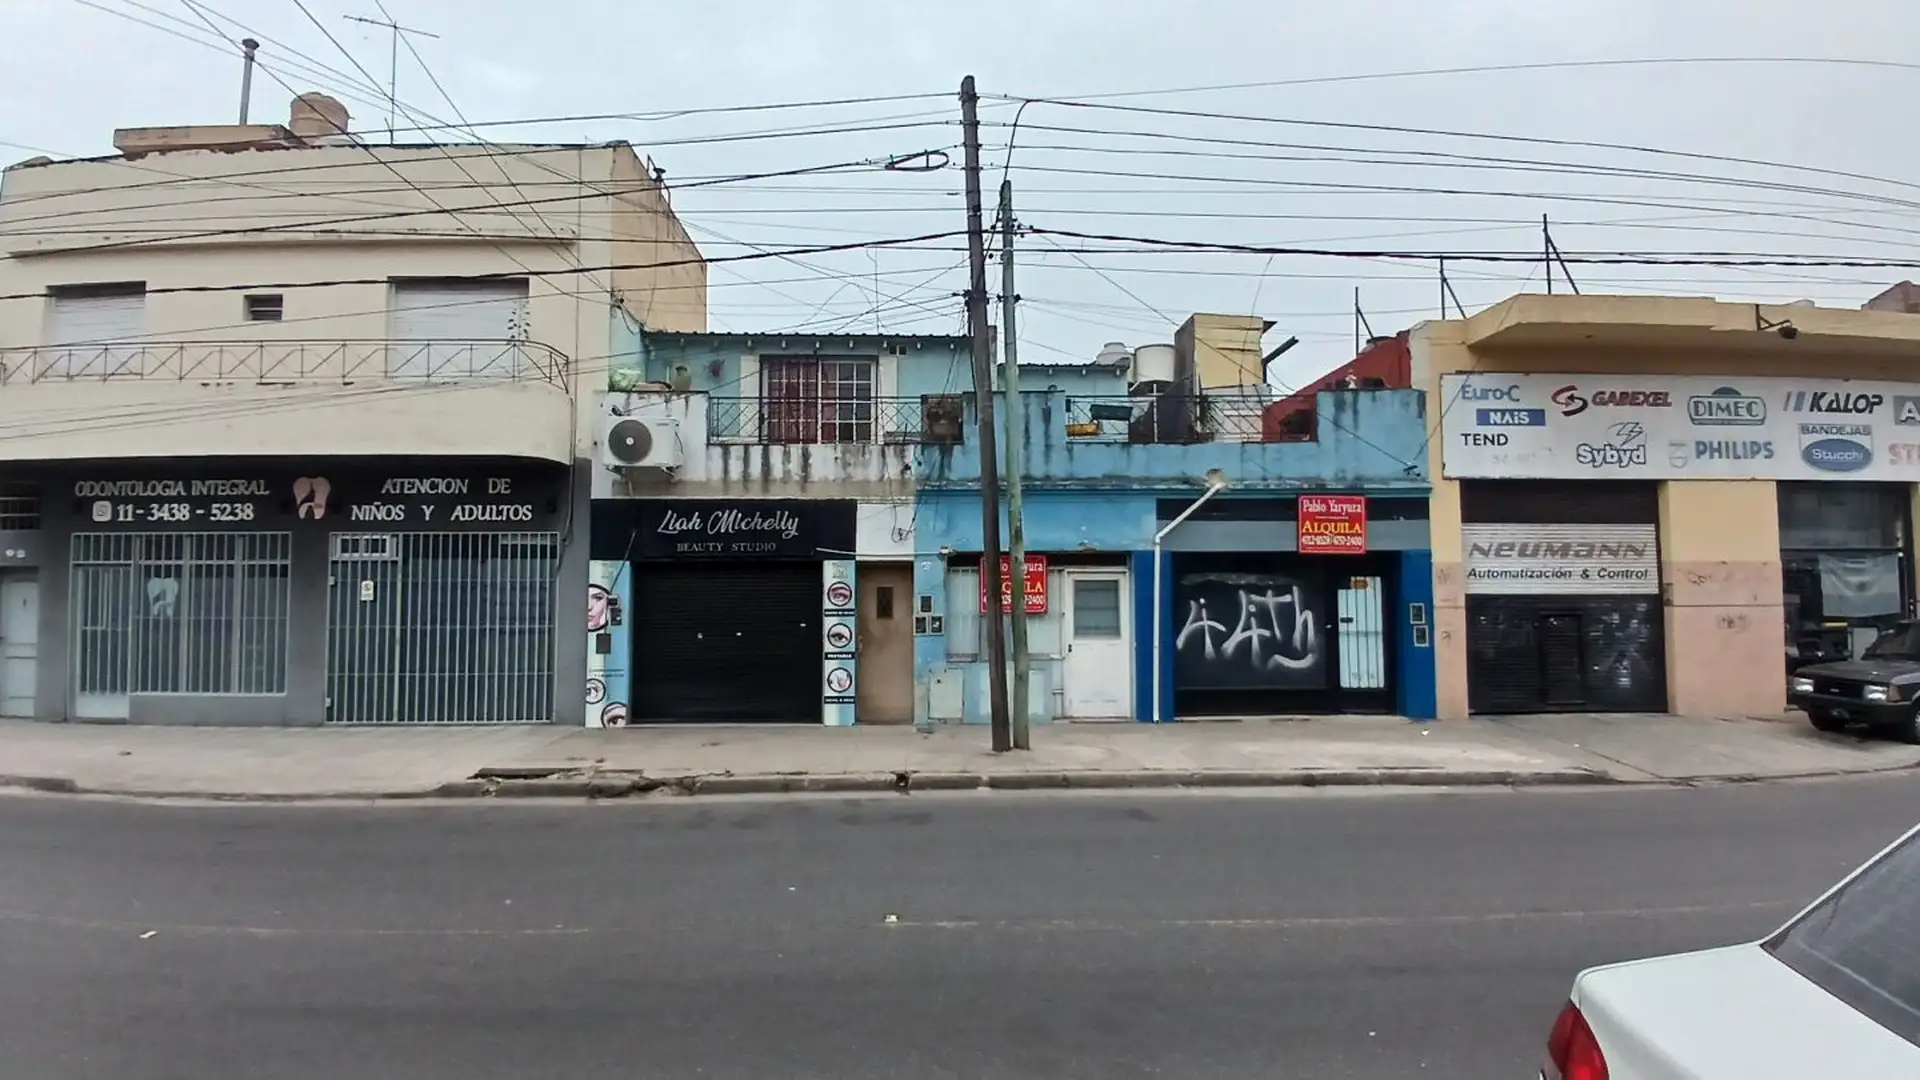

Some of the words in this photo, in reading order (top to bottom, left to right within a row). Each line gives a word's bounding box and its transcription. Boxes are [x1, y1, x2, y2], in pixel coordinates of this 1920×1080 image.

[1693, 400, 1760, 418] DIMEC
[1809, 391, 1884, 414] KALOP
[1801, 425, 1872, 437] BANDEJAS
[1461, 433, 1509, 447] TEND
[1576, 443, 1647, 468] Sybyd
[1695, 440, 1775, 460] PHILIPS
[1812, 448, 1864, 461] Stucchi
[75, 479, 187, 497] ODONTOLOGIA
[191, 479, 270, 496] INTEGRAL
[381, 477, 469, 494] ATENCION
[487, 477, 512, 494] DE
[351, 502, 405, 521] NIÑOS
[421, 505, 435, 521] Y
[450, 504, 533, 521] ADULTOS
[1303, 499, 1327, 512] Pablo
[1302, 520, 1362, 536] ALQUILA
[676, 542, 725, 553] BEAUTY
[731, 542, 777, 552] STUDIO
[1467, 566, 1572, 580] Automatización
[1580, 567, 1590, 579] &
[1597, 567, 1648, 579] Control
